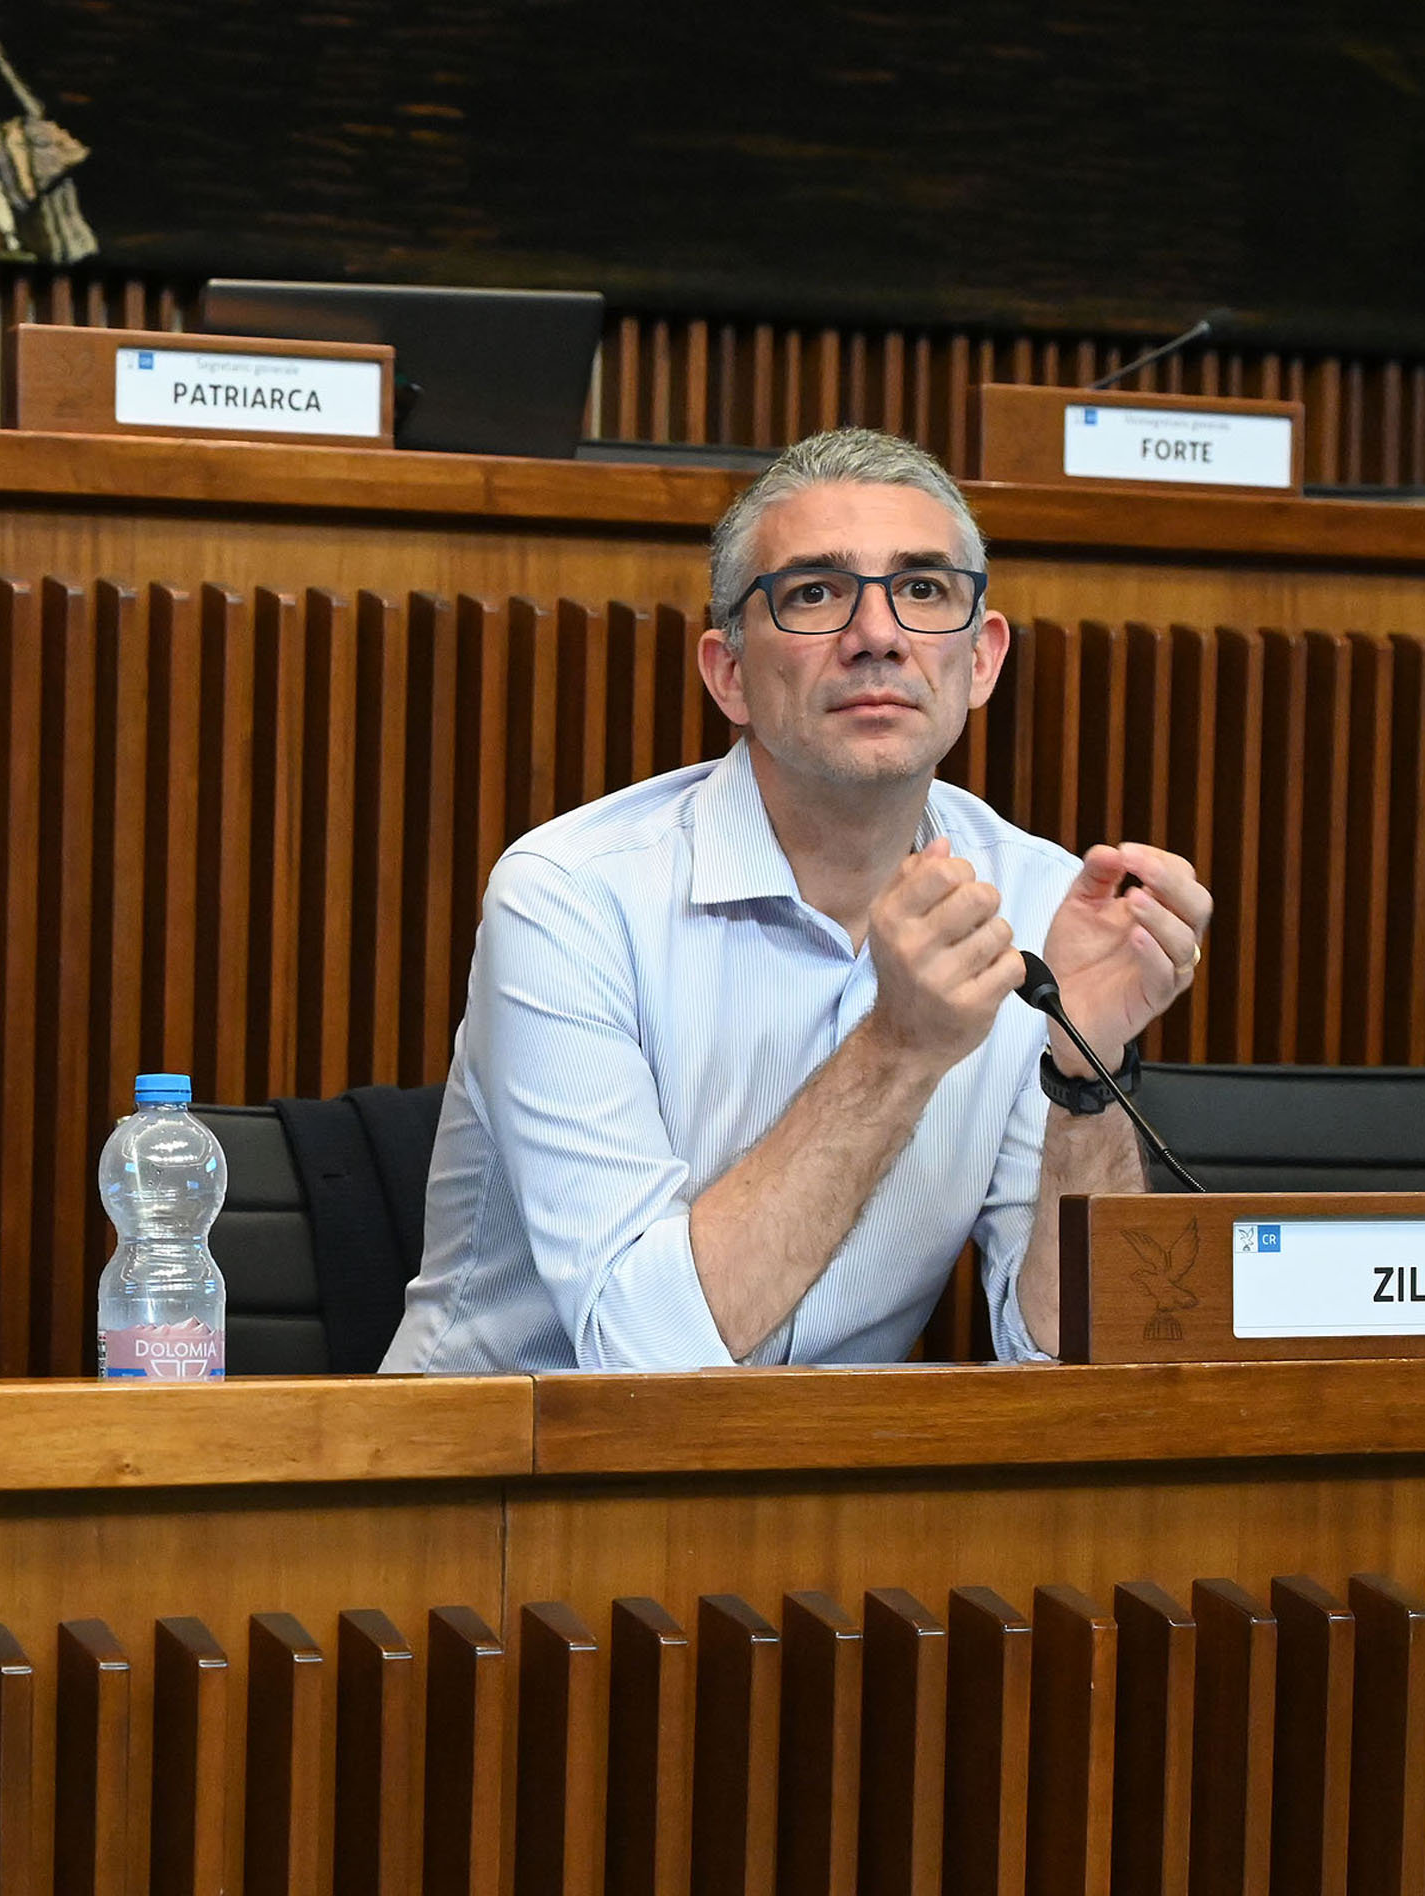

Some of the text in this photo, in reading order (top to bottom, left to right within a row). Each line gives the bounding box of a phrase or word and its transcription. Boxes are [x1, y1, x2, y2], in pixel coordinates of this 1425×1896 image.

[174, 382, 322, 412] PATRIARCA
[1142, 438, 1213, 464] FORTE
[1261, 1233, 1277, 1246] CR
[1373, 1266, 1425, 1302] ZIL
[135, 1339, 217, 1358] DOLOMIA
